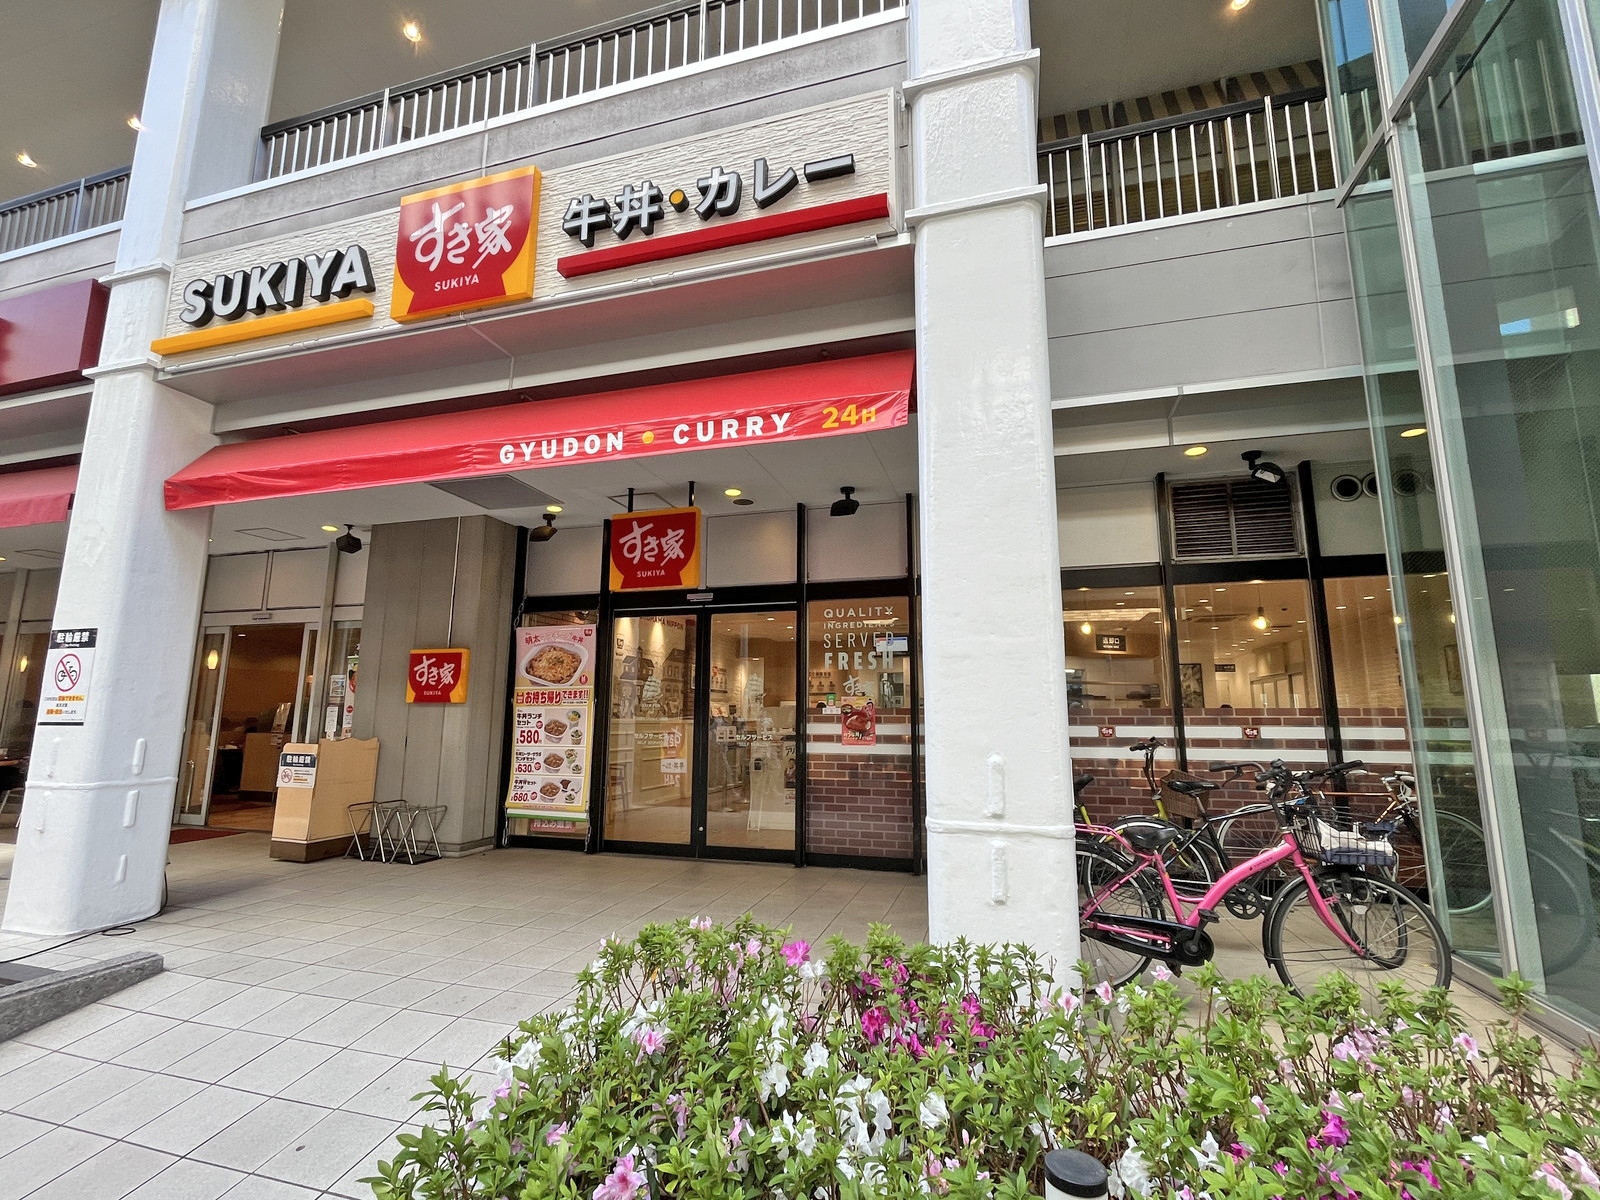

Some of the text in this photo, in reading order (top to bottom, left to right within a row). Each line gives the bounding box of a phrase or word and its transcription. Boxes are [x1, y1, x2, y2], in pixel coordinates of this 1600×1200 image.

[409, 201, 514, 272] すき家
[179, 244, 374, 327] SUKIYA
[434, 274, 480, 292] SUKIYA
[499, 404, 876, 465] GYUDON CURRY 24H
[619, 520, 685, 567] すき家
[636, 569, 666, 578] SUKIYA
[823, 606, 894, 619] QUALITY
[823, 631, 894, 649] SERVED
[413, 655, 456, 689] すき家
[824, 651, 894, 671] FRESH
